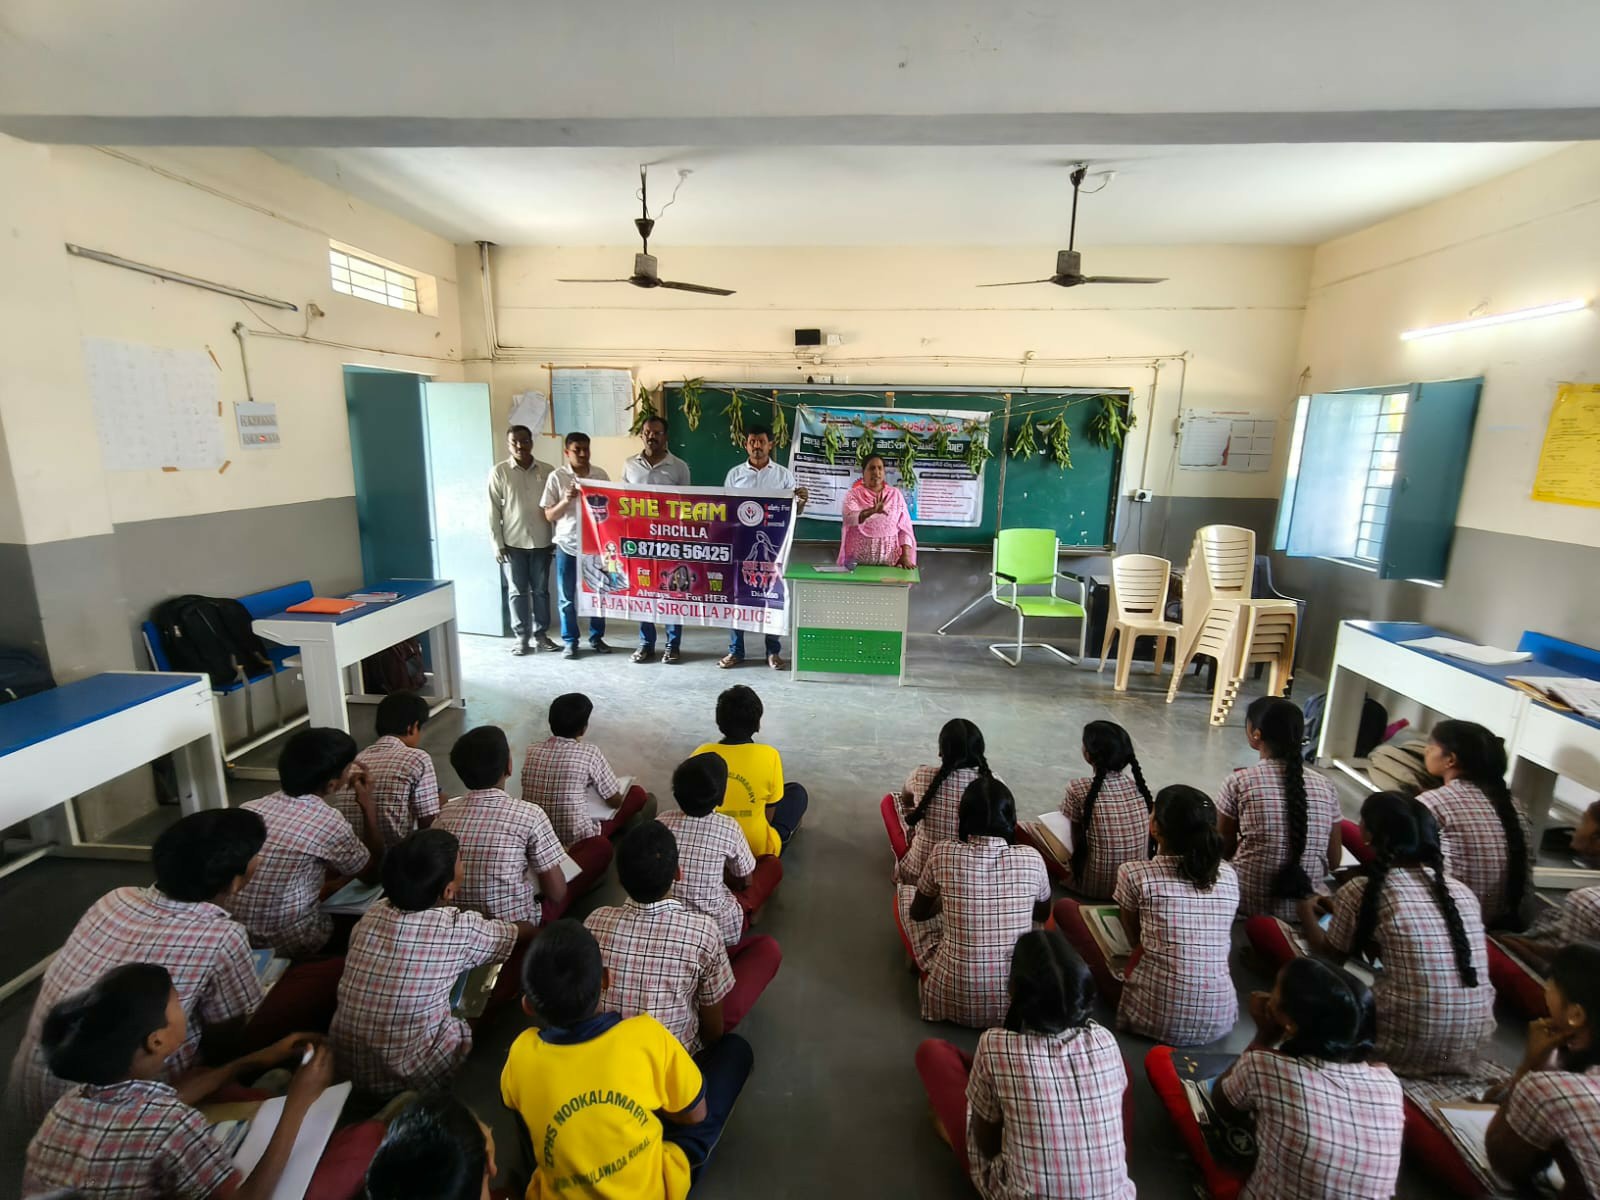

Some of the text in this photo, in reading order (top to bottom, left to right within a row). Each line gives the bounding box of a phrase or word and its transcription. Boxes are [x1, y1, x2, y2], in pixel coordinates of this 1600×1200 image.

[618, 497, 727, 522] SHE TEAM
[649, 523, 708, 539] SIRCILLA
[638, 541, 730, 561] 87126 56425
[704, 594, 728, 603] HER
[591, 596, 772, 624] RAJANNA SIRCILLA POLICE
[628, 1136, 650, 1159] RURAL
